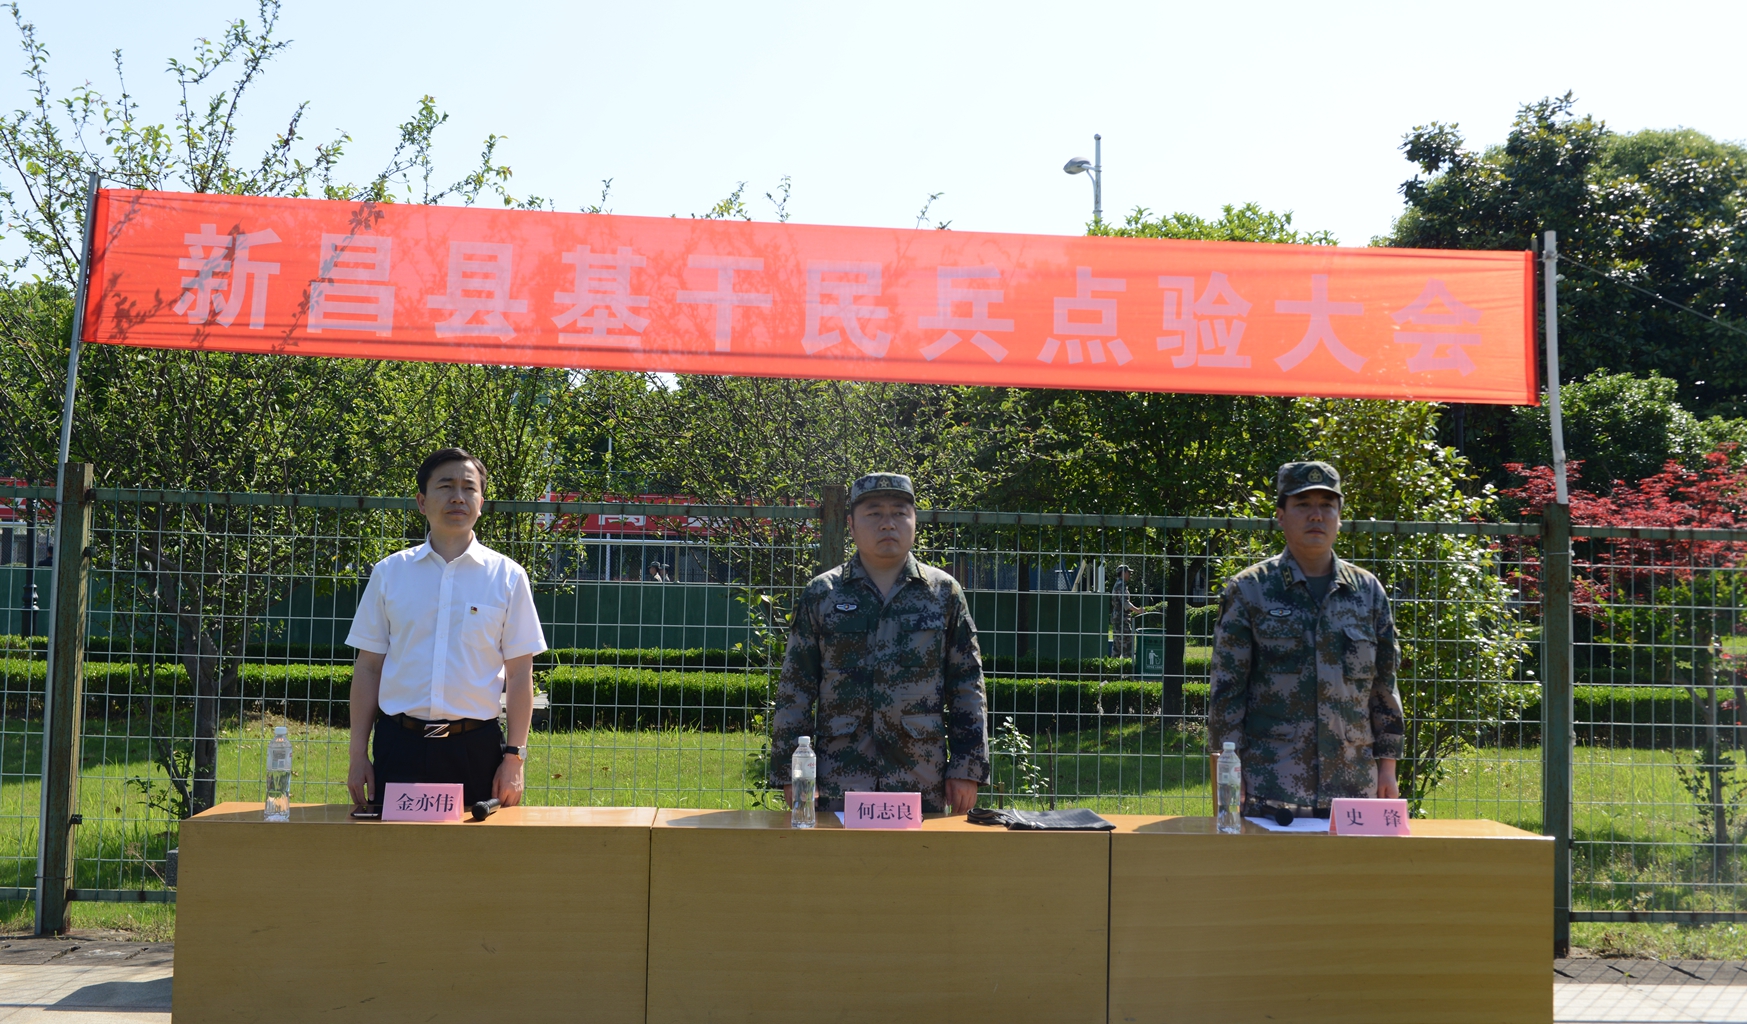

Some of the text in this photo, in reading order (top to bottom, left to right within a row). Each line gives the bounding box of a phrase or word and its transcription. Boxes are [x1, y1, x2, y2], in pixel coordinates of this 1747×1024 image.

[174, 223, 1481, 375] 新昌县基干民兵点验大会
[395, 792, 454, 813] 金亦伟
[856, 801, 914, 821] 何志良
